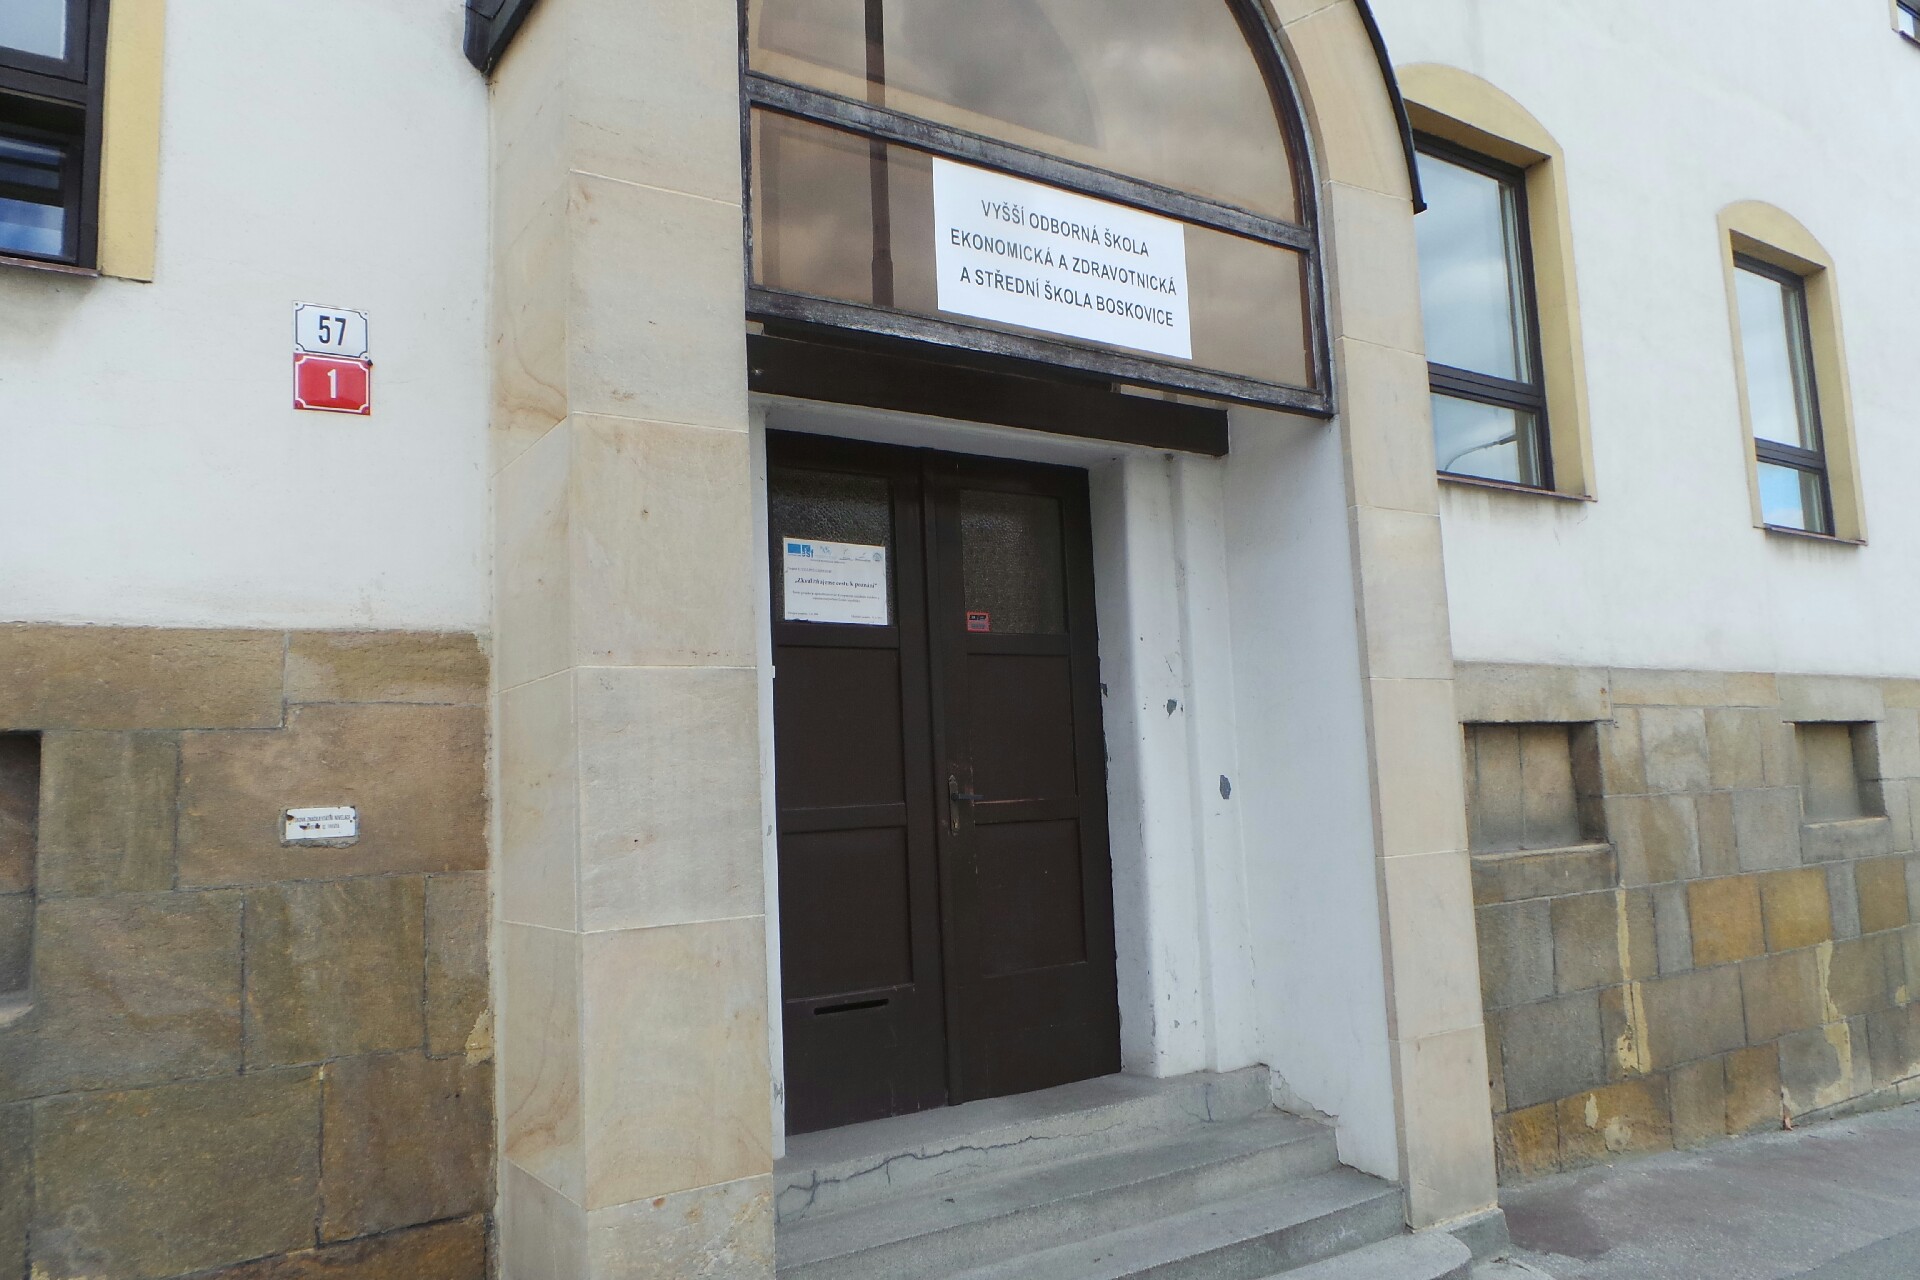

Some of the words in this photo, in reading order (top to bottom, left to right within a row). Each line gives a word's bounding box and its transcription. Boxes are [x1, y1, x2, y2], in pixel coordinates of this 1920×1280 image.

[981, 199, 1025, 226] VYŠŠÍ
[1029, 213, 1101, 245] ODBORNÁ
[1104, 228, 1149, 257] ŠKOLA
[950, 228, 1054, 266] EKONOMICKÁ
[1058, 254, 1068, 270] A
[1072, 257, 1177, 295] ZDRAVOTNICKÁ
[960, 266, 971, 283] A
[975, 269, 1040, 298] STŘEDNÍ
[1044, 280, 1092, 309] ŠKOLA
[1096, 295, 1174, 327] BOSKOVICE
[318, 314, 347, 346] 57
[327, 368, 337, 399] 1
